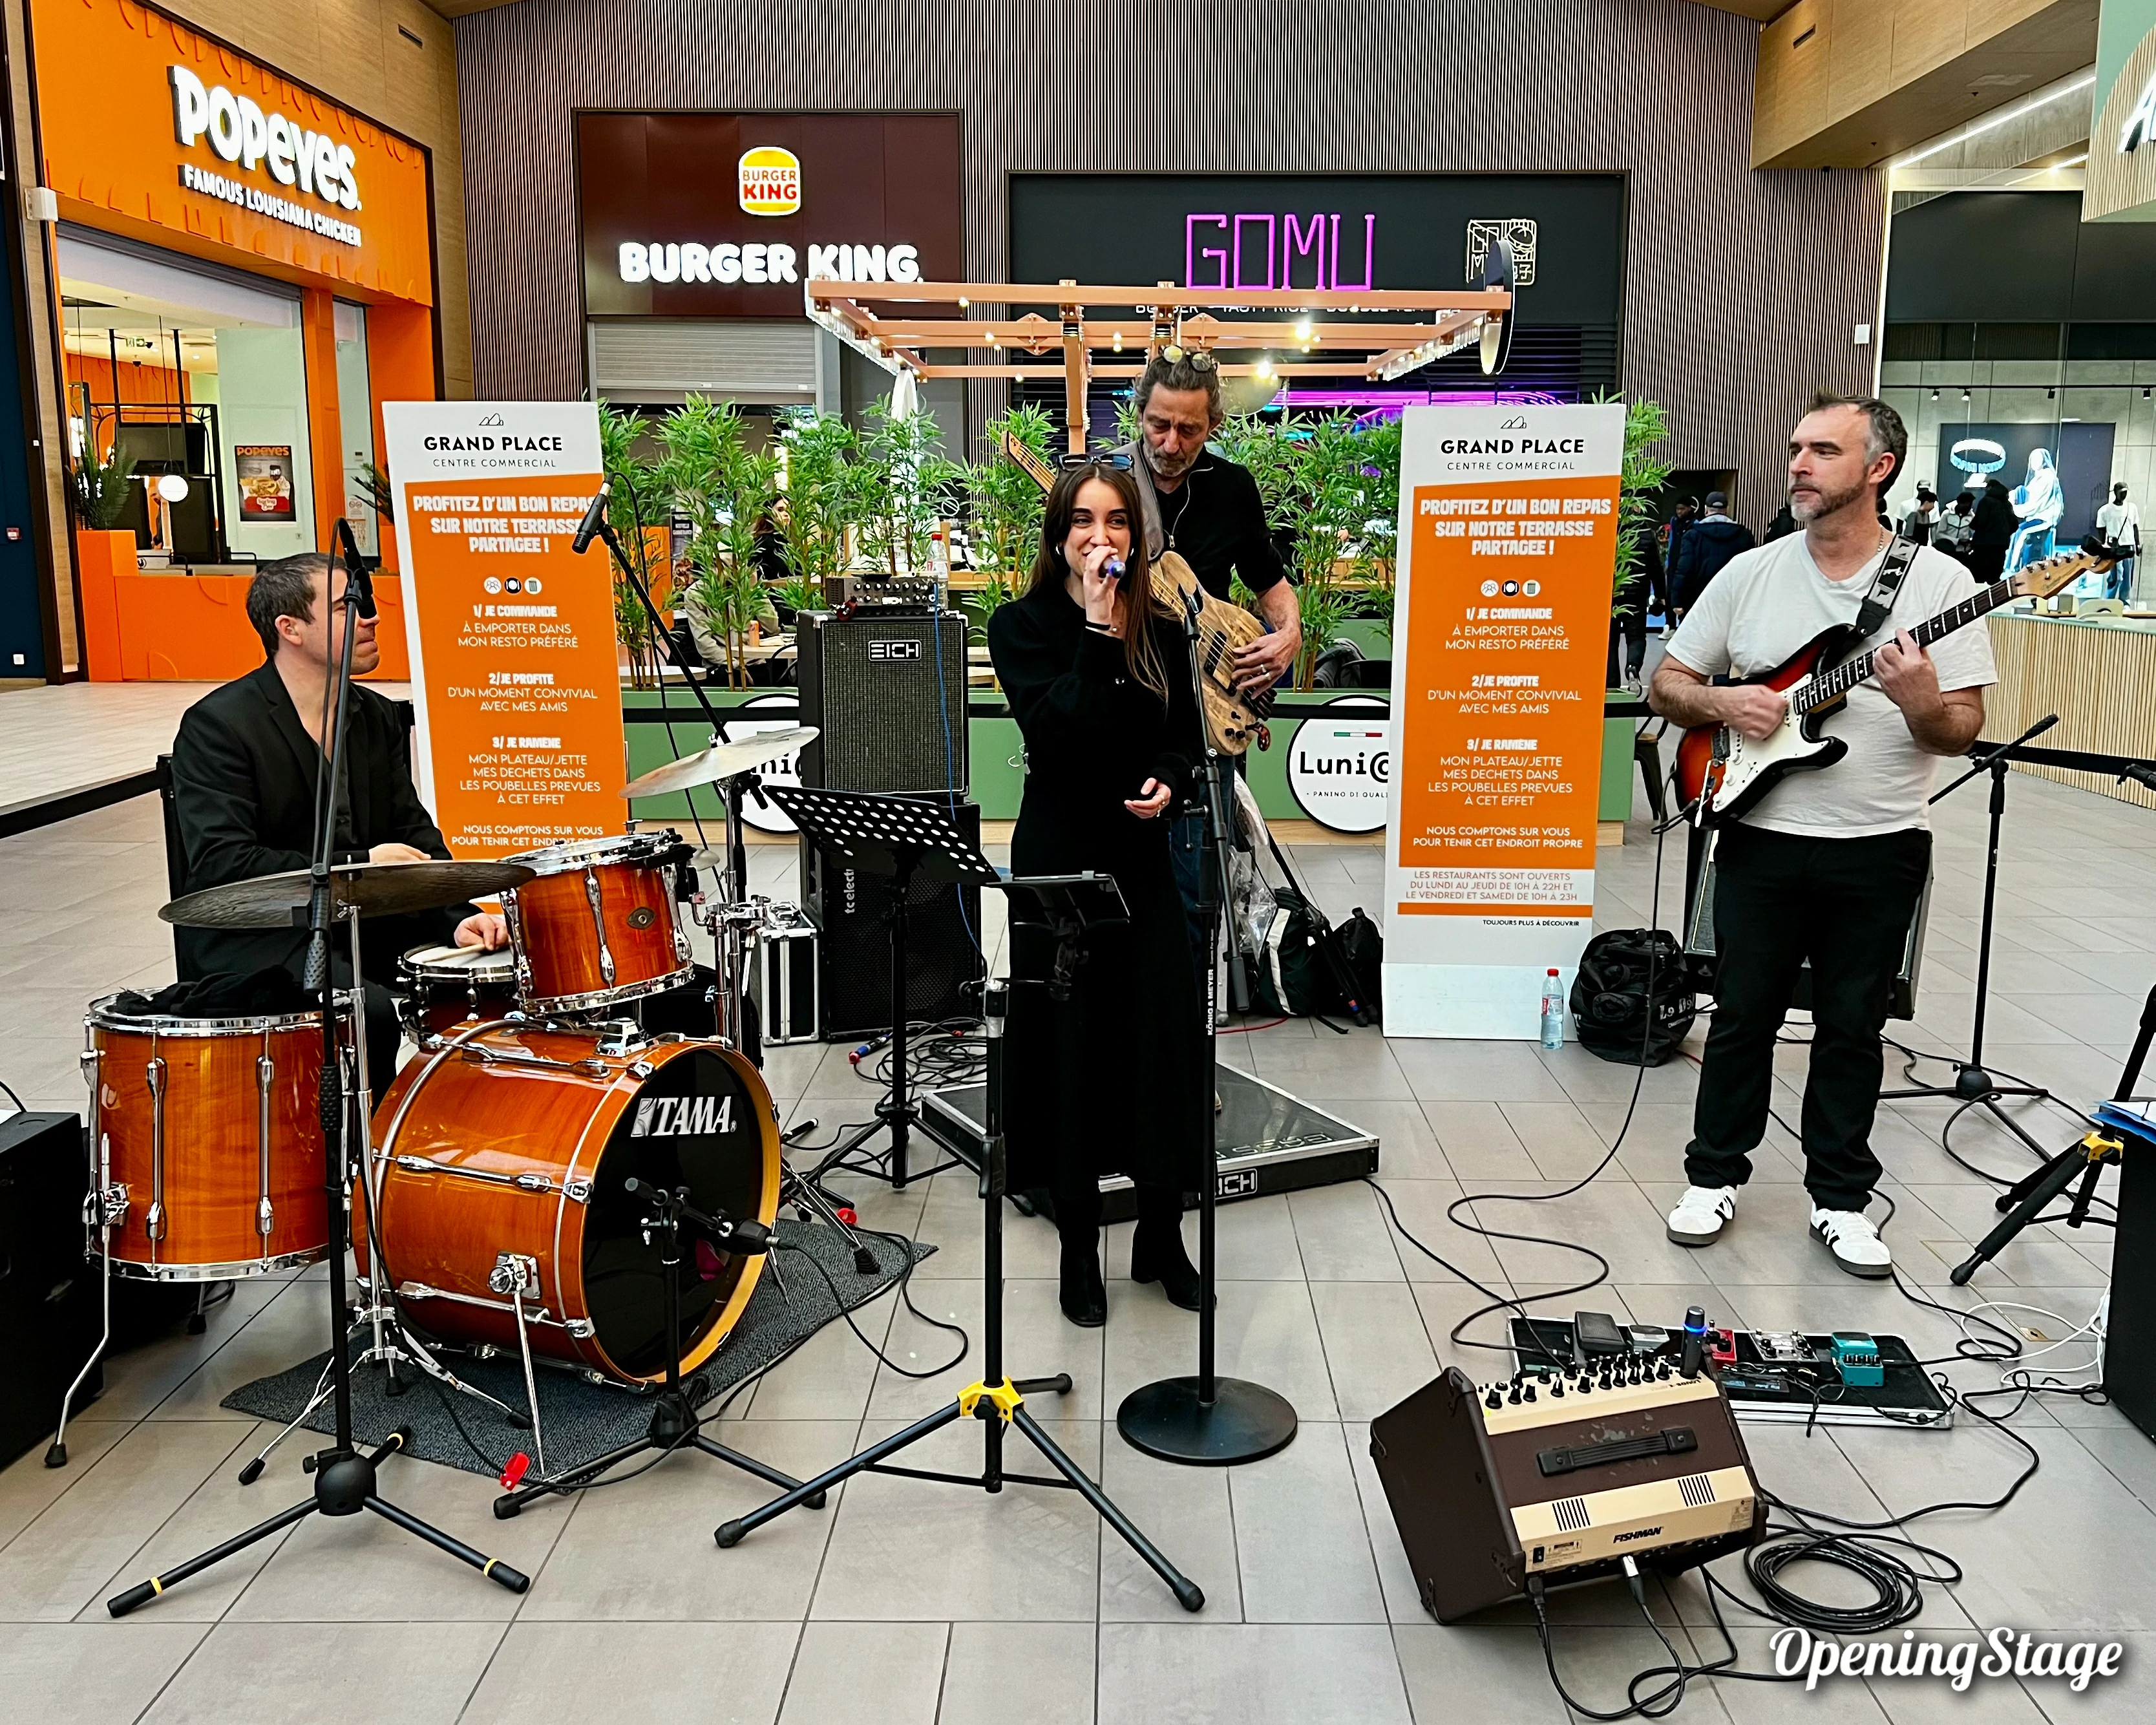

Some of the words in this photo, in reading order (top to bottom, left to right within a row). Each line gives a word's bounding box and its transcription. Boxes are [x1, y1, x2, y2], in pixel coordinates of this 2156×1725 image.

[742, 169, 797, 182] BURGER
[743, 184, 798, 201] KING
[184, 165, 246, 205] FAMOUS
[246, 189, 313, 231] LOUISIANA
[314, 213, 361, 248] CHICKEN
[1185, 213, 1376, 292] GOMU
[618, 242, 798, 284] BURGER
[425, 437, 494, 450] GRAND
[502, 437, 562, 450] PLACE
[1441, 439, 1513, 454] GRAND
[1522, 439, 1583, 453] PLACE
[413, 496, 480, 511] PROFITEZ
[519, 496, 548, 512] BON
[1421, 500, 1489, 514] PROFITEZ
[1530, 499, 1559, 514] BON
[1563, 499, 1611, 514] REPAS
[431, 518, 460, 533] SUR
[463, 518, 509, 533] NOTRE
[1435, 522, 1465, 536] SUR
[1468, 521, 1515, 536] NOTRE
[1519, 521, 1594, 536] TERRASSE
[469, 537, 541, 552] PARTAGEE
[544, 538, 549, 553] !
[1472, 540, 1546, 555] PARTAGEE
[1549, 540, 1554, 555] !
[485, 606, 495, 616] JE
[497, 606, 557, 617] COMMANDE
[1477, 608, 1488, 619] JE
[1490, 608, 1552, 619] COMMANDE
[475, 623, 535, 633] EMPORTER
[540, 624, 571, 633] DANS
[1465, 626, 1527, 635] EMPORTER
[1532, 626, 1563, 635] DANS
[459, 637, 487, 646] MON
[491, 637, 527, 647] RESTO
[531, 636, 577, 647] PRÉFÉRÉ
[1446, 640, 1475, 649] MON
[1479, 640, 1516, 649] RESTO
[1521, 637, 1569, 649] PRÉFÉRÉ
[871, 643, 919, 658] EICH
[513, 673, 554, 684] PROFITE
[1497, 676, 1539, 686] PROFITE
[479, 688, 530, 697] MOMENT
[534, 688, 598, 698] CONVIVIAL
[1459, 690, 1512, 699] MOMENT
[1517, 691, 1581, 700] CONVIVIAL
[481, 701, 509, 711] AVEC
[513, 702, 536, 711] MES
[540, 702, 567, 711] AMIS
[1459, 704, 1488, 713] AVEC
[1493, 704, 1516, 713] MES
[1520, 704, 1548, 714] AMIS
[507, 737, 519, 748] JE
[1481, 739, 1492, 750] JE
[469, 754, 497, 763] MON
[1441, 756, 1469, 765] MON
[474, 768, 496, 777] MES
[500, 768, 551, 778] DECHETS
[554, 768, 585, 778] DANS
[1444, 770, 1467, 778] MES
[1472, 770, 1523, 779] DECHETS
[1527, 770, 1558, 779] DANS
[461, 781, 480, 790] LES
[483, 781, 547, 790] POUBELLES
[551, 781, 600, 791] PREVUES
[1429, 783, 1448, 792] LES
[1452, 783, 1517, 792] POUBELLES
[1521, 783, 1572, 792] PREVUES
[509, 794, 529, 803] CET
[533, 794, 564, 804] EFFET
[1477, 796, 1497, 805] CET
[1502, 796, 1534, 805] EFFET
[464, 825, 492, 834] NOUS
[495, 825, 551, 834] COMPTONS
[555, 826, 572, 834] SUR
[576, 827, 603, 835] VOUS
[1520, 827, 1538, 836] SUR
[482, 837, 509, 845] TENIR
[651, 1096, 732, 1136] TAMA
[1613, 1527, 1662, 1543] FISHMAN
